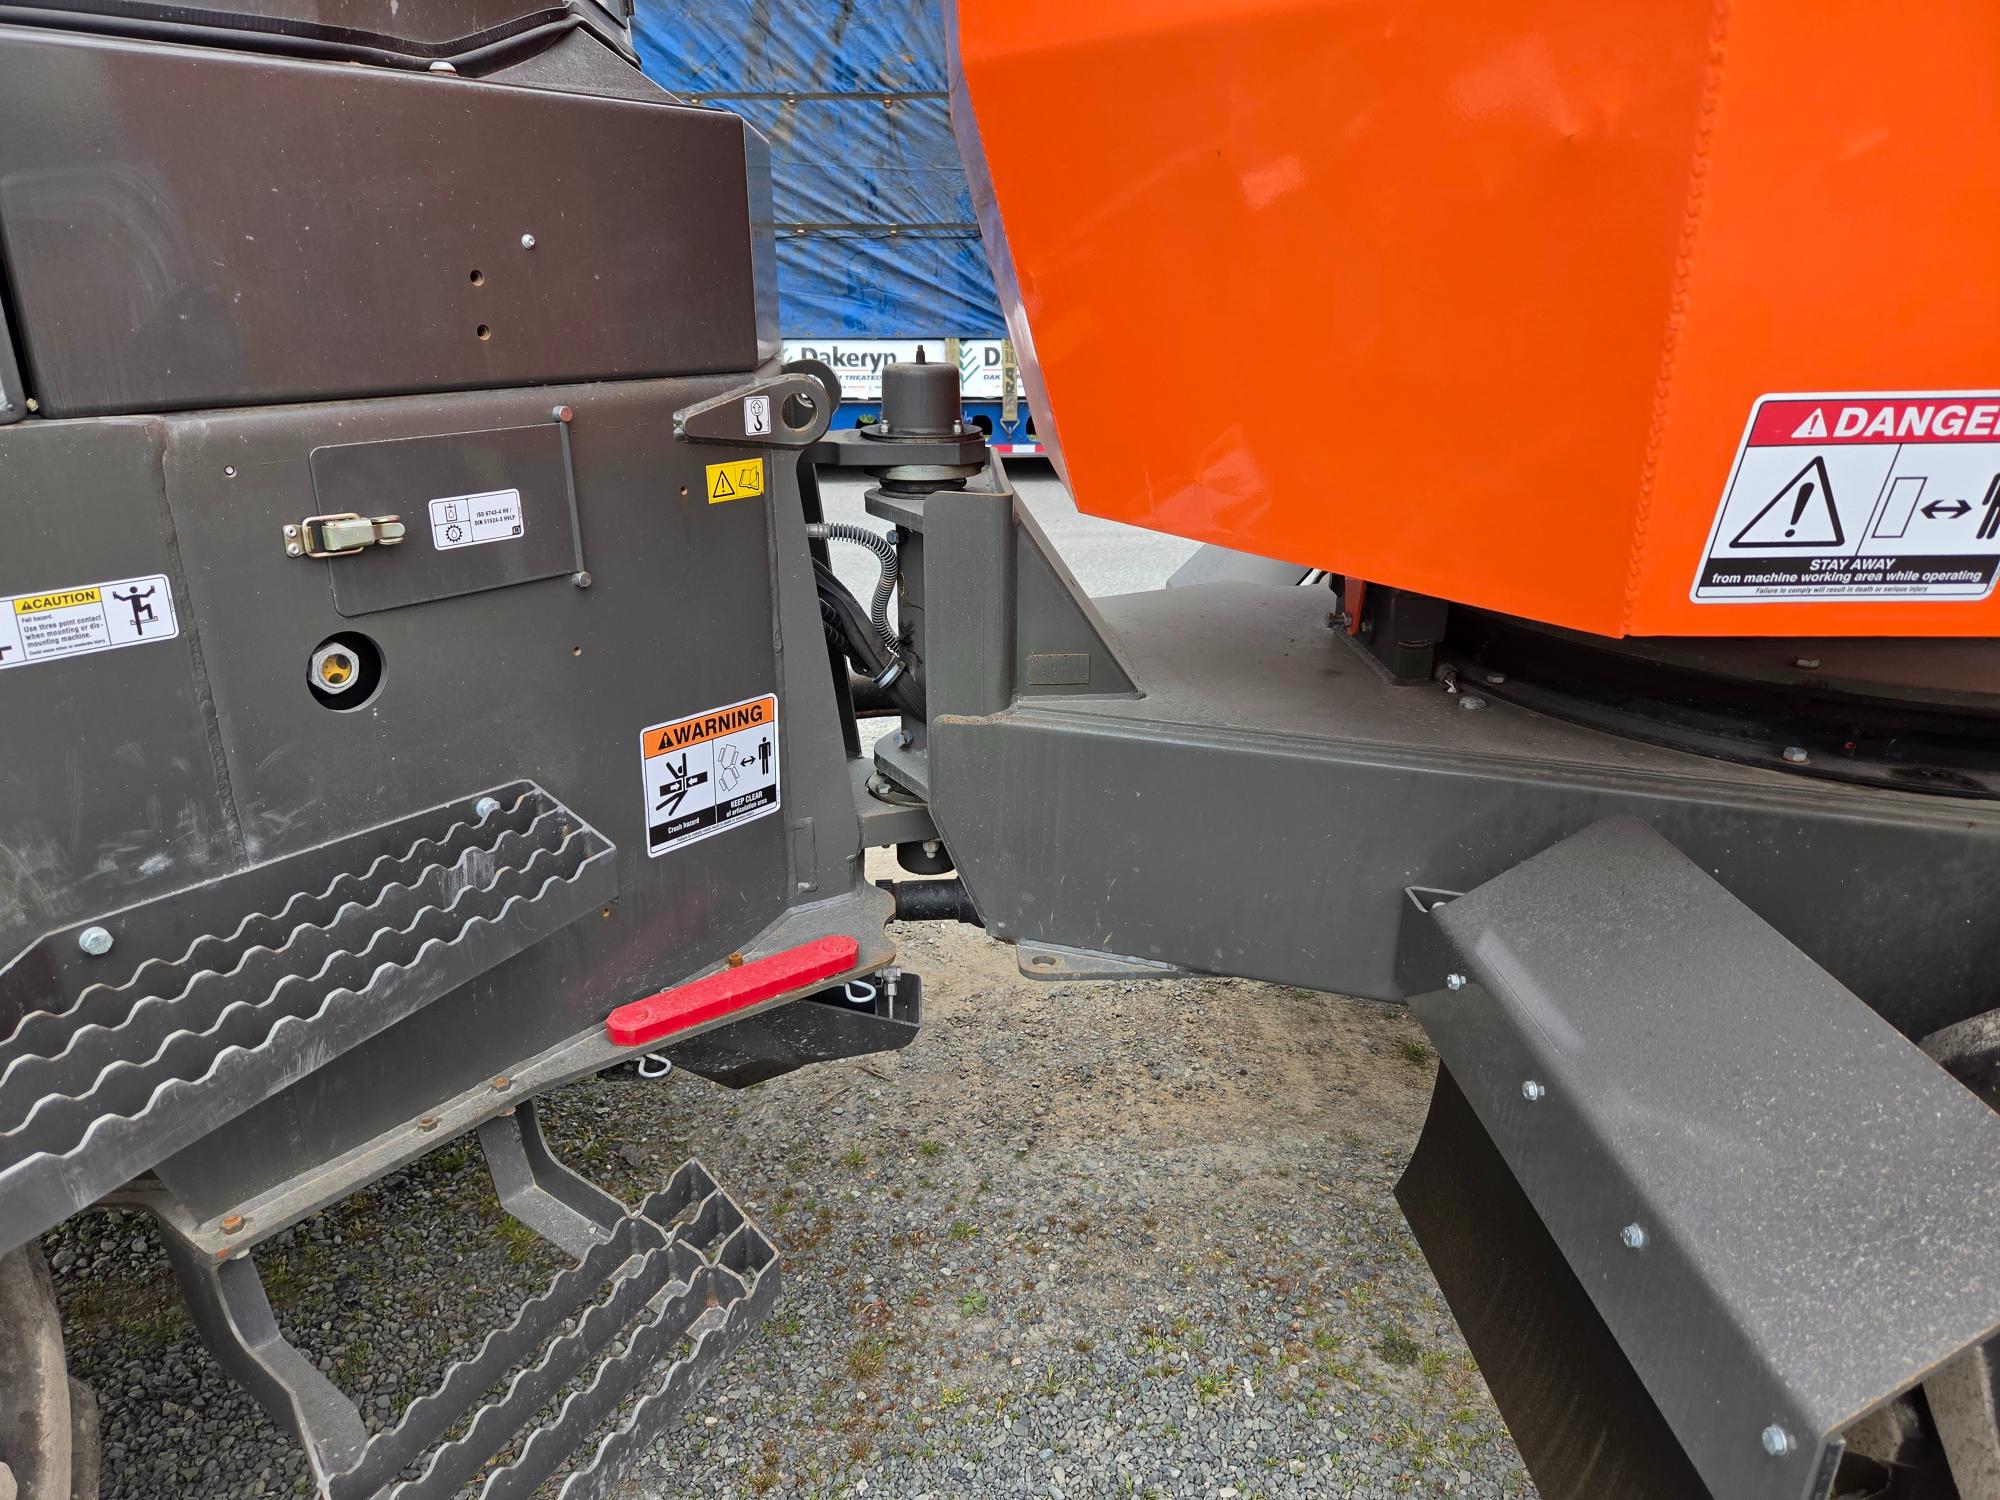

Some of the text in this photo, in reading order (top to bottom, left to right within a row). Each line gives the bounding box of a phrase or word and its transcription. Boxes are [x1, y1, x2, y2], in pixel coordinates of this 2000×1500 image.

[801, 346, 898, 374] Dakeryn
[1833, 405, 2000, 438] DANGE
[1810, 558, 1896, 571] STAY AWAY
[1712, 573, 1740, 584] from
[1744, 572, 1798, 583] machine
[1801, 572, 1852, 584] working
[1854, 572, 1882, 581] area
[1886, 570, 1919, 581] while
[1922, 570, 1982, 583] operating
[32, 590, 96, 610] CAUTION
[59, 618, 76, 627] point
[77, 614, 101, 624] contact
[25, 632, 45, 640] when
[46, 626, 79, 636] mounting
[27, 638, 59, 648] mounting
[673, 704, 763, 745] WARNING
[730, 797, 744, 808] KEEP
[746, 791, 762, 804] CLEAR
[732, 802, 757, 817] articulation
[758, 798, 767, 806] area
[668, 817, 700, 834] Crush hazard
